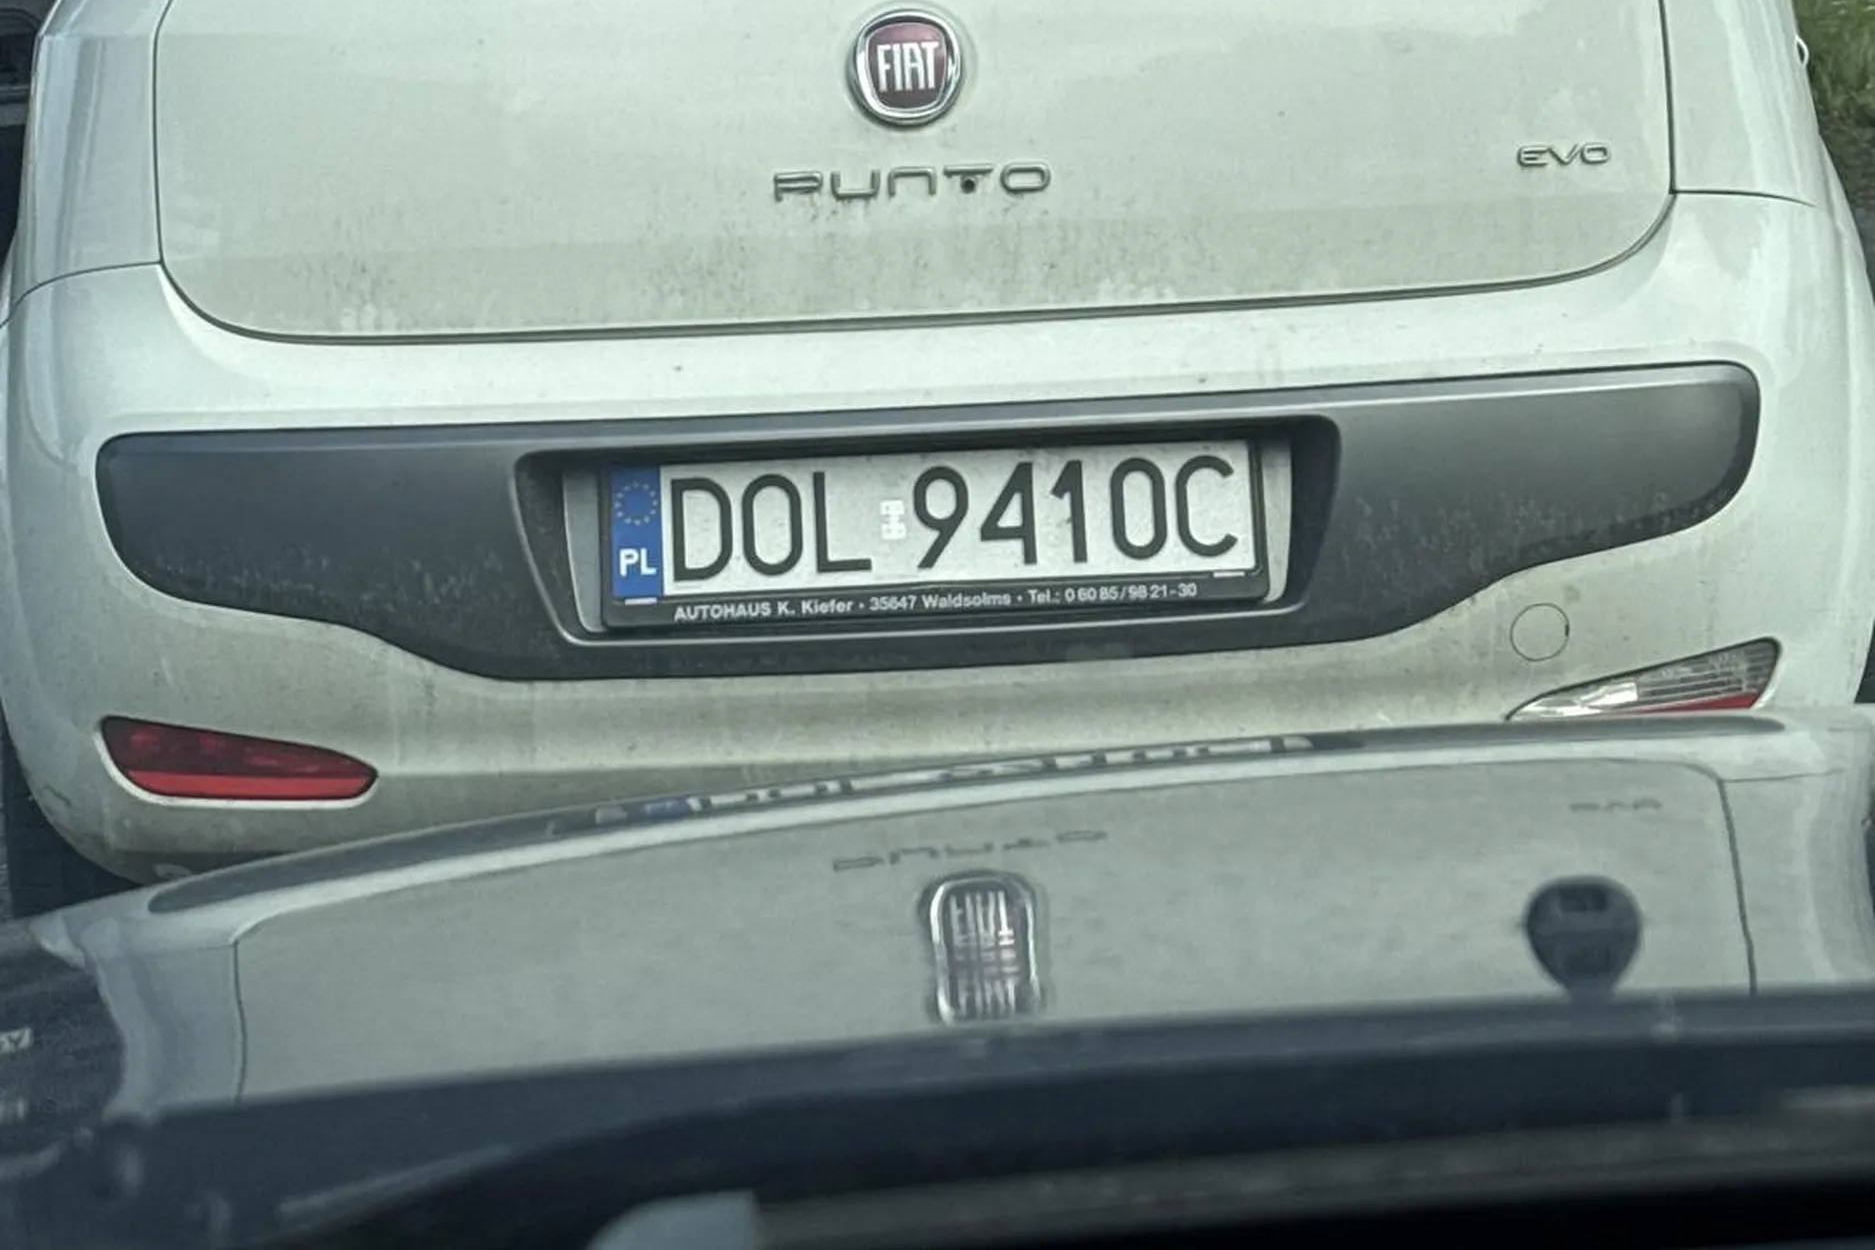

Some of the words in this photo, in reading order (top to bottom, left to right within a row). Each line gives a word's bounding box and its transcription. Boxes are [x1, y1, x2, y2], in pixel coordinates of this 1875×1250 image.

[876, 41, 940, 93] FIAT
[1517, 143, 1611, 168] EVO
[773, 161, 1051, 202] PUNTO
[670, 471, 872, 582] DOL
[913, 454, 1239, 569] 9410C
[619, 548, 658, 577] PL
[674, 602, 772, 622] AUTOHAUS
[778, 600, 796, 616] K.
[802, 597, 854, 615] Kiefer
